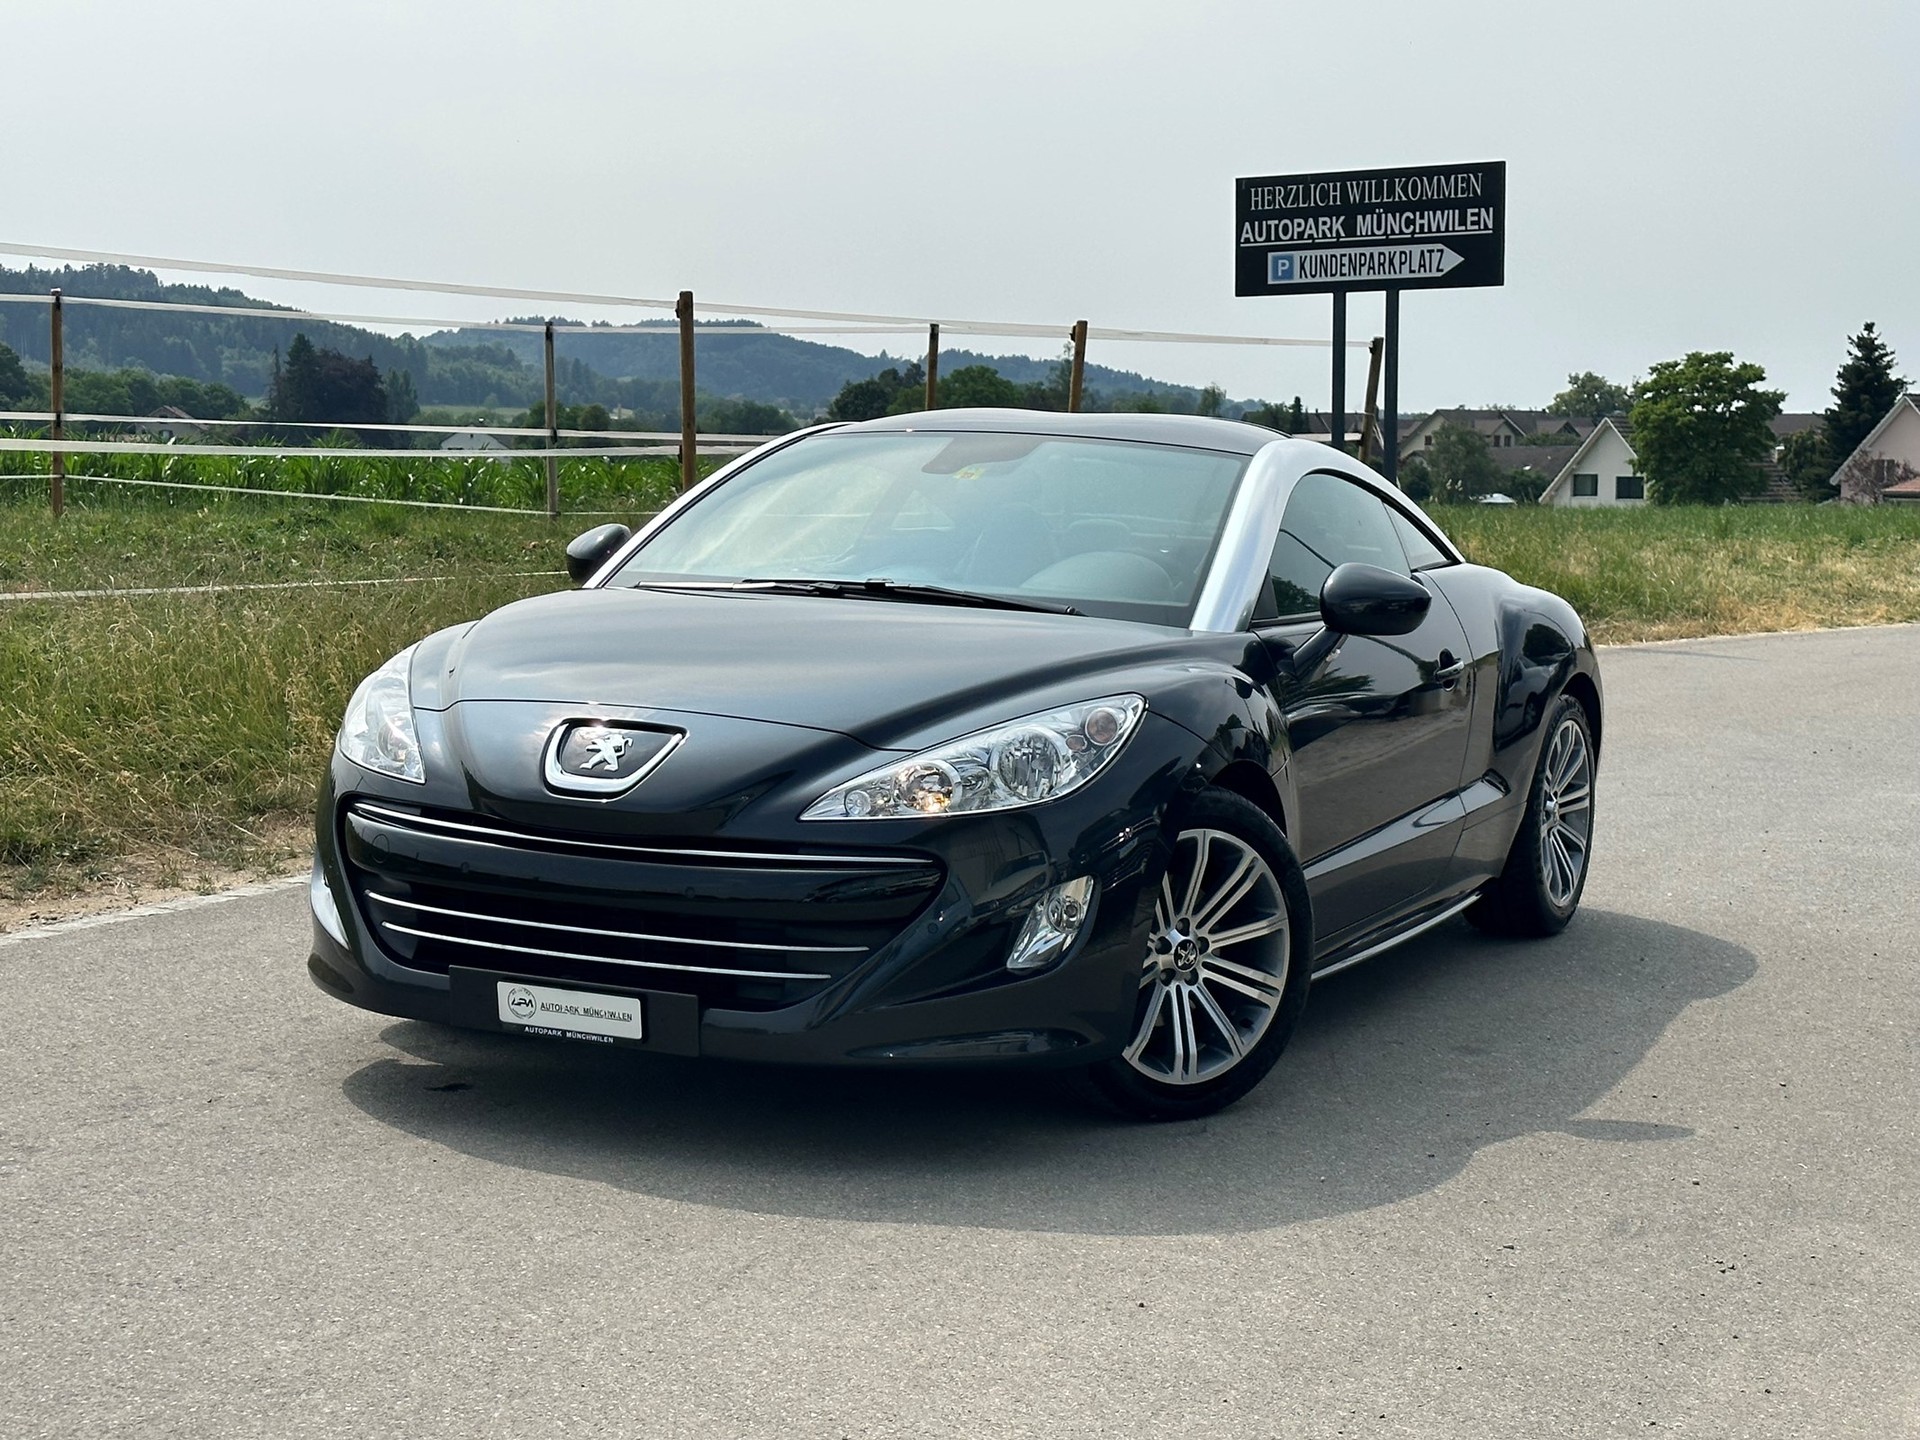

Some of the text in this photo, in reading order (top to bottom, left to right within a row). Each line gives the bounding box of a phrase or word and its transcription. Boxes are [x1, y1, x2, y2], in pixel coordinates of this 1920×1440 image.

[1250, 173, 1482, 210] HERZLICH WILLKOMMEN
[1240, 208, 1493, 242] AUTOPARK MÜNCHWILEN
[1277, 248, 1444, 279] P KUNDENPARKPLATZ
[524, 1026, 614, 1043] AUTOPARK MÜNCHWILEN
